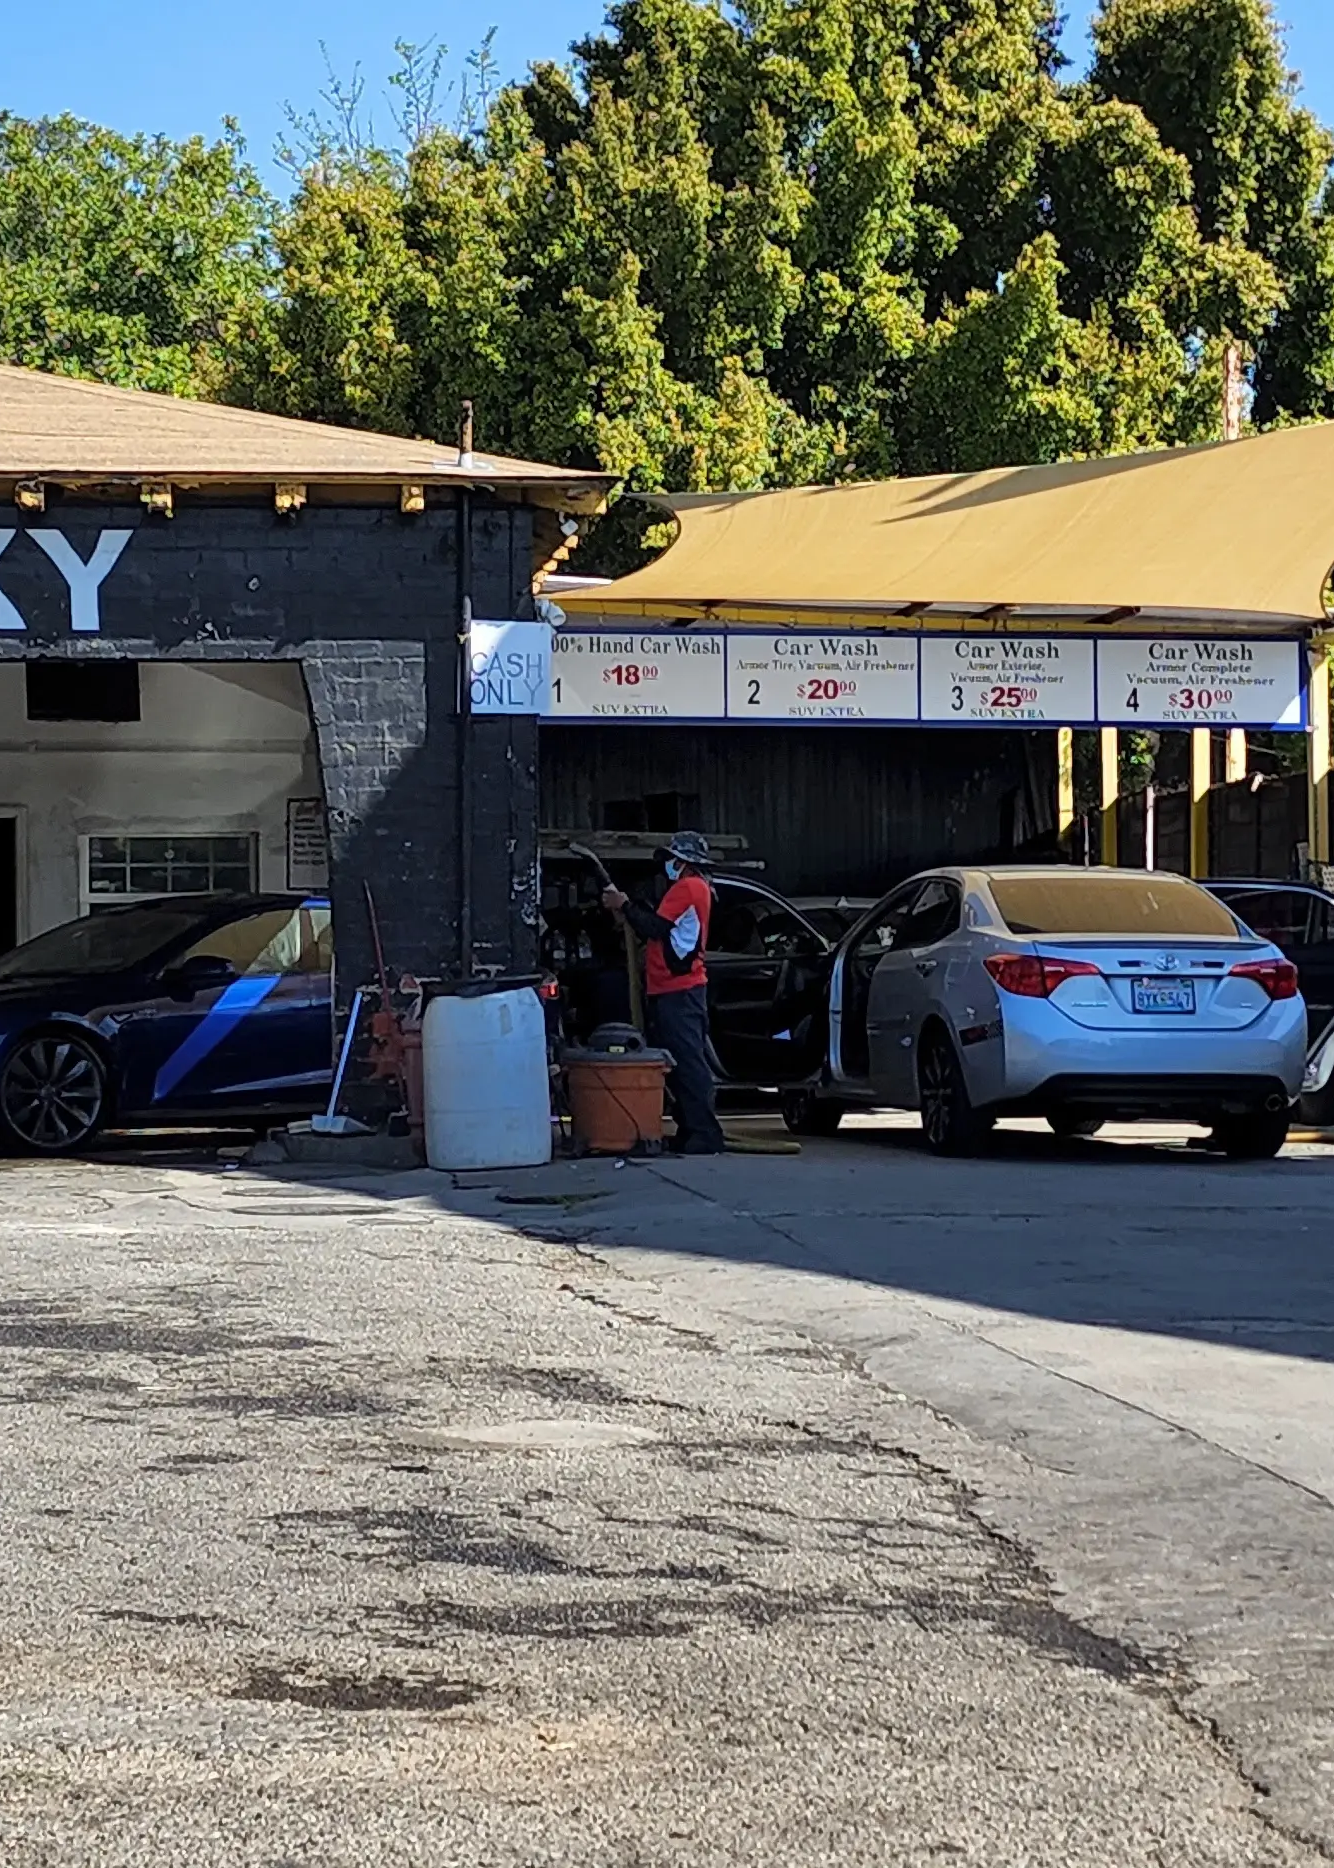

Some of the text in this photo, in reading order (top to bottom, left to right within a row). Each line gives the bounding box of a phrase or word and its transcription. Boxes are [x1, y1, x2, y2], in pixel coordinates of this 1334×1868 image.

[589, 636, 634, 654] Hand
[640, 637, 671, 654] Car
[676, 638, 721, 655] Wash
[773, 638, 879, 656] Car Wash
[954, 640, 1060, 659] Car Wash
[1148, 642, 1254, 661] Car Wash
[471, 651, 543, 679] CASH
[845, 660, 861, 671] Air
[1146, 662, 1252, 674] Armor Complete
[1185, 674, 1206, 685] Air
[1210, 674, 1275, 686] Freshener
[470, 679, 544, 706] ONLY
[552, 677, 562, 703] 1
[747, 679, 760, 705] 2
[951, 685, 964, 711] 3
[1126, 687, 1139, 712] 4
[592, 704, 668, 715] SUV EXTRA
[789, 706, 865, 717] SUV EXTRA
[970, 708, 1045, 719] SUV EXTRA
[1162, 711, 1238, 720] SUV EXTRA
